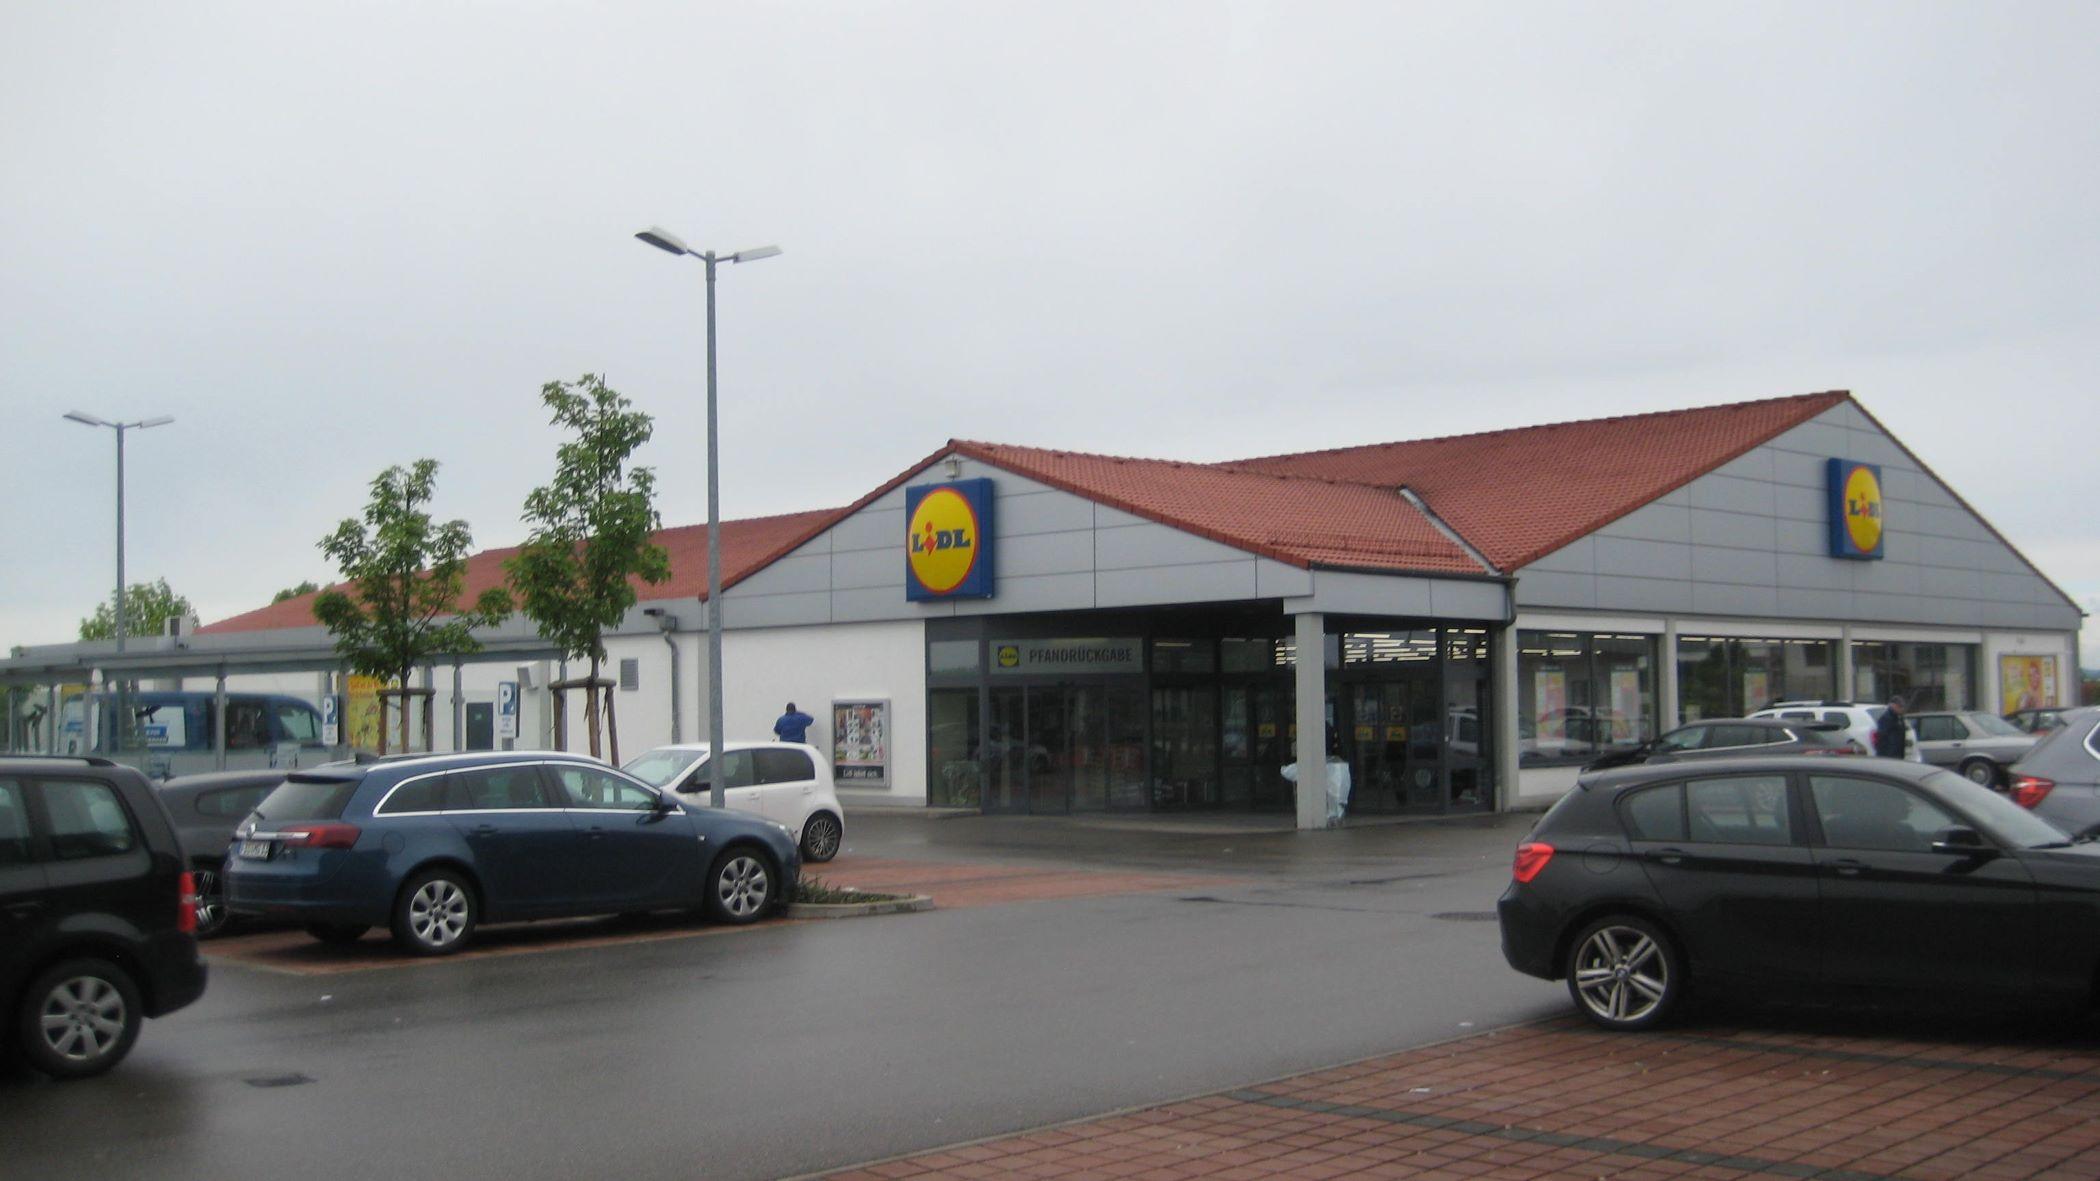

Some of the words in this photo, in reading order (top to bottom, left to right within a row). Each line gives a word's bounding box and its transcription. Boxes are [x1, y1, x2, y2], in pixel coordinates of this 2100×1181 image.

[1030, 646, 1133, 663] PFANDRÜCKGABE
[323, 697, 334, 722] P
[500, 684, 512, 714] P
